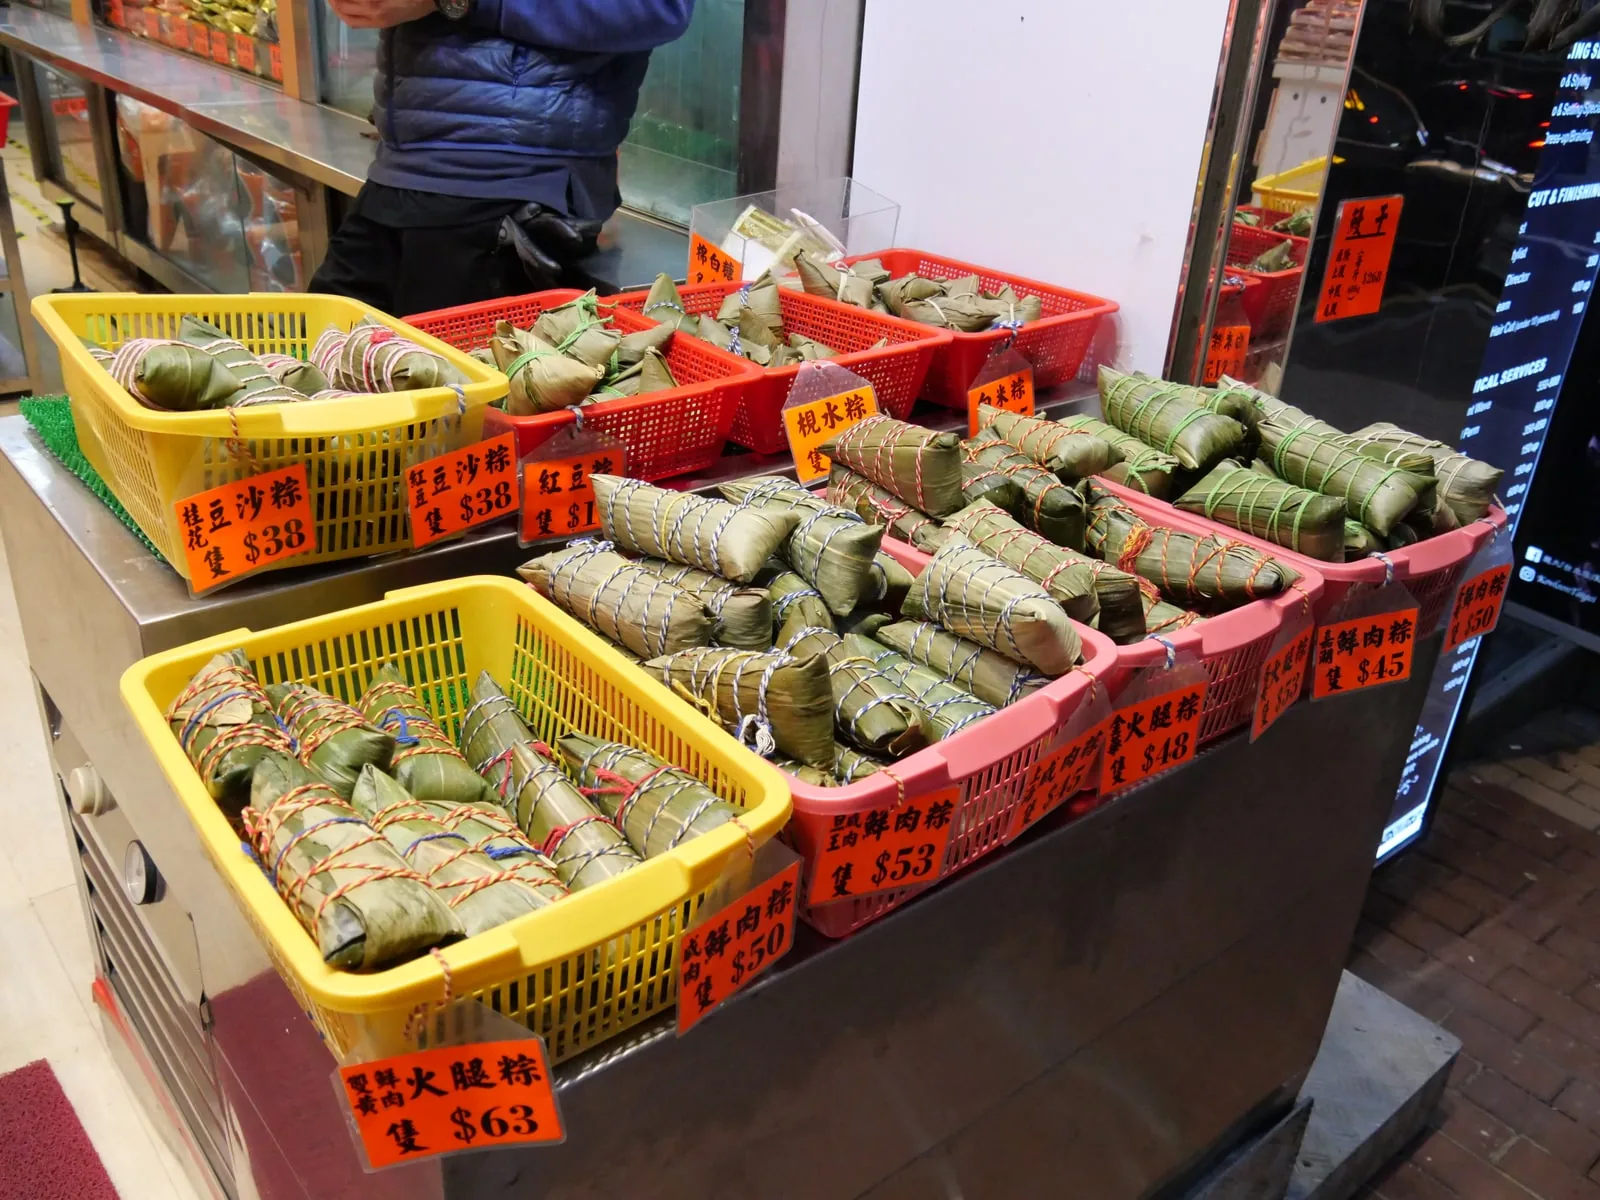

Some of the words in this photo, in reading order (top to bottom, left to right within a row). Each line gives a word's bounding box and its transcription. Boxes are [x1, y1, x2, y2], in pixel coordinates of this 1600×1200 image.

[1528, 190, 1551, 208] CUT
[1548, 188, 1558, 205] &
[1500, 357, 1548, 385] SERVICES
[431, 444, 511, 496] 豆沙粽
[807, 447, 829, 474] 隻
[182, 503, 209, 550] 桂花
[209, 476, 303, 533] 豆沙粽
[424, 508, 447, 536] 隻
[460, 481, 512, 523] $38
[536, 509, 555, 535] 隻
[204, 546, 230, 579] 隻
[243, 518, 306, 565] $38
[1337, 618, 1413, 657] 鮮肉粽
[1464, 604, 1494, 636] $50
[1325, 666, 1344, 692] 隻
[1357, 651, 1405, 685] $45
[1124, 692, 1201, 742] 火腿粽
[1110, 756, 1126, 785] 隻
[1142, 732, 1190, 774] $48
[862, 800, 954, 842] 鮮肉粽
[831, 862, 854, 897] 隻
[871, 844, 936, 887] $53
[704, 881, 793, 964] 鮮肉粽
[695, 975, 716, 1013] 隻
[731, 923, 785, 985] $50
[406, 1053, 542, 1100] 火腿粽
[386, 1118, 431, 1156] 隻
[450, 1104, 539, 1145] $63
